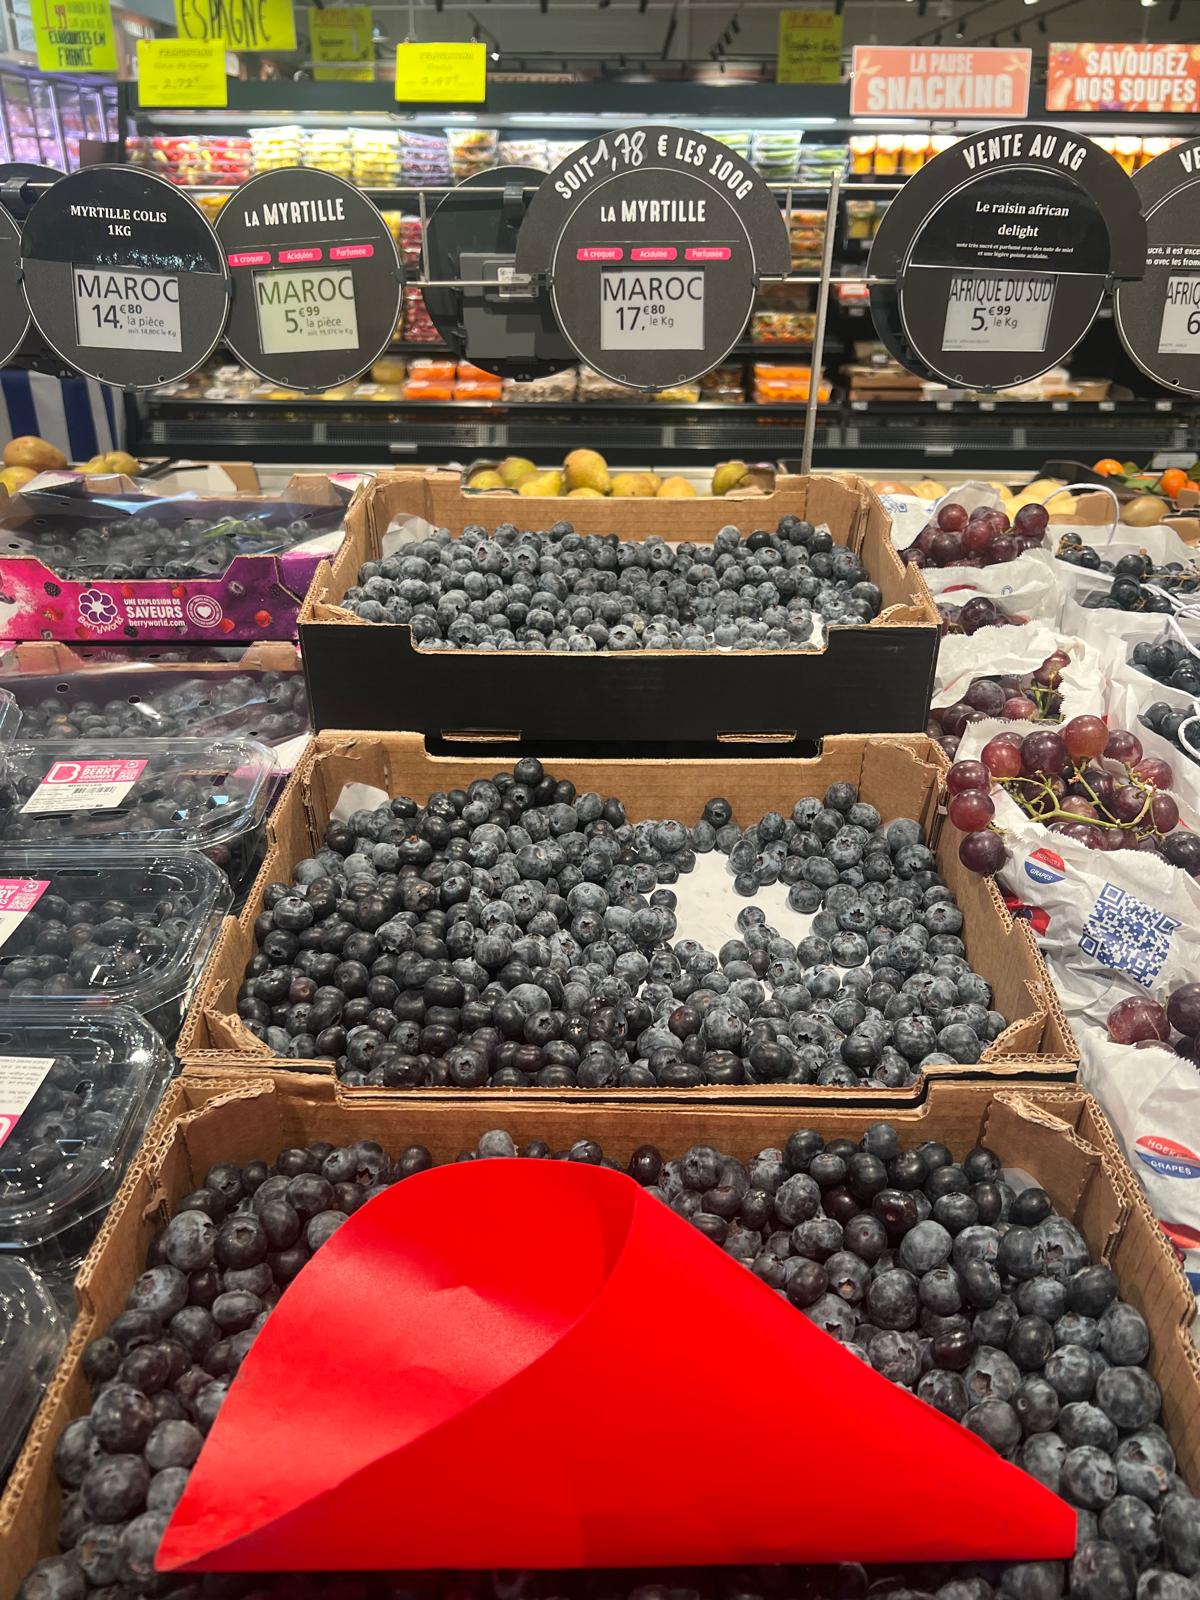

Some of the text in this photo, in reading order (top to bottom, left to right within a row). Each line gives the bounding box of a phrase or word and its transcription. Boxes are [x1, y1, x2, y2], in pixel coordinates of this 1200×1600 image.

[181, 0, 271, 47] ESPAGNE
[58, 46, 93, 66] FRANCE
[909, 53, 973, 73] LA PAUSE
[1085, 51, 1188, 76] SAVOUREZ
[867, 75, 1013, 110] SNACKING
[1074, 77, 1196, 102] NOS SOUPES
[962, 133, 1087, 171] VENTE AU KG
[554, 130, 753, 200] SOIT 1,78 € LES 100G
[70, 204, 167, 223] MYRTILLE COLIS
[244, 198, 345, 227] LA MYRTILLE
[601, 200, 706, 223] LA MYRTILLE
[975, 201, 1070, 217] Le raisin african
[107, 224, 132, 237] 1KG
[997, 224, 1040, 239] delight
[1153, 258, 1170, 266] avec
[1171, 257, 1182, 266] les
[1183, 257, 1200, 266] from
[77, 274, 179, 303] MAROC
[258, 276, 354, 306] MAROC
[603, 277, 702, 301] MAROC
[950, 278, 1053, 305] AFRIQUE DU SUD
[127, 316, 165, 327] la pièce
[306, 317, 341, 328] la pièce
[650, 316, 674, 328] le Kg
[993, 317, 1018, 329] le Kg
[137, 598, 172, 606] EXPLOSION
[173, 598, 181, 606] DE
[126, 605, 183, 619] SAVEURS
[77, 614, 124, 634] BerryWorld
[128, 619, 186, 629] berryworld.com
[82, 767, 119, 775] BERRY
[1029, 868, 1053, 881] GRAPES
[1150, 1160, 1192, 1175] GRAPES
